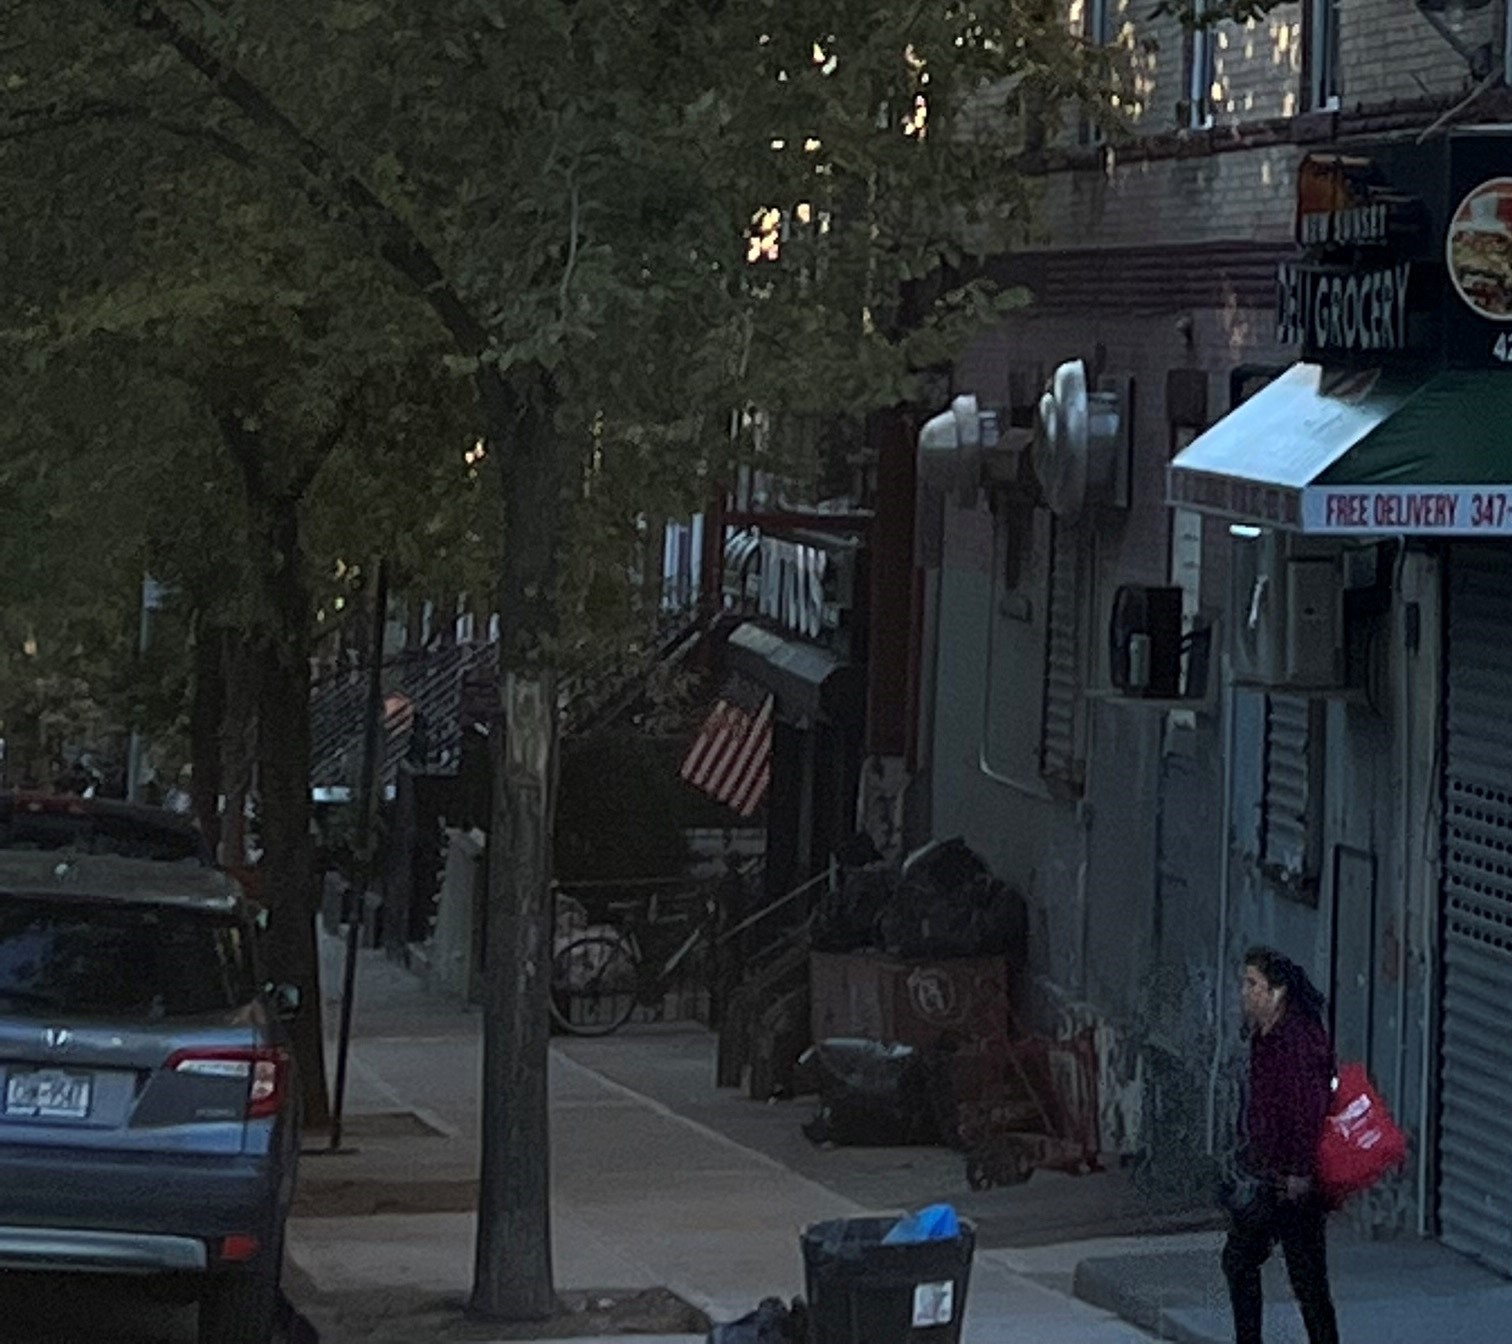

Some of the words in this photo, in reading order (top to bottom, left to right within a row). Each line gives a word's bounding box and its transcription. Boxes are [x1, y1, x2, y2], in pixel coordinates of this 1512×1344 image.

[1315, 261, 1411, 350] GROCERY
[1326, 493, 1369, 526] FREE
[1373, 493, 1459, 527] DELIVERY
